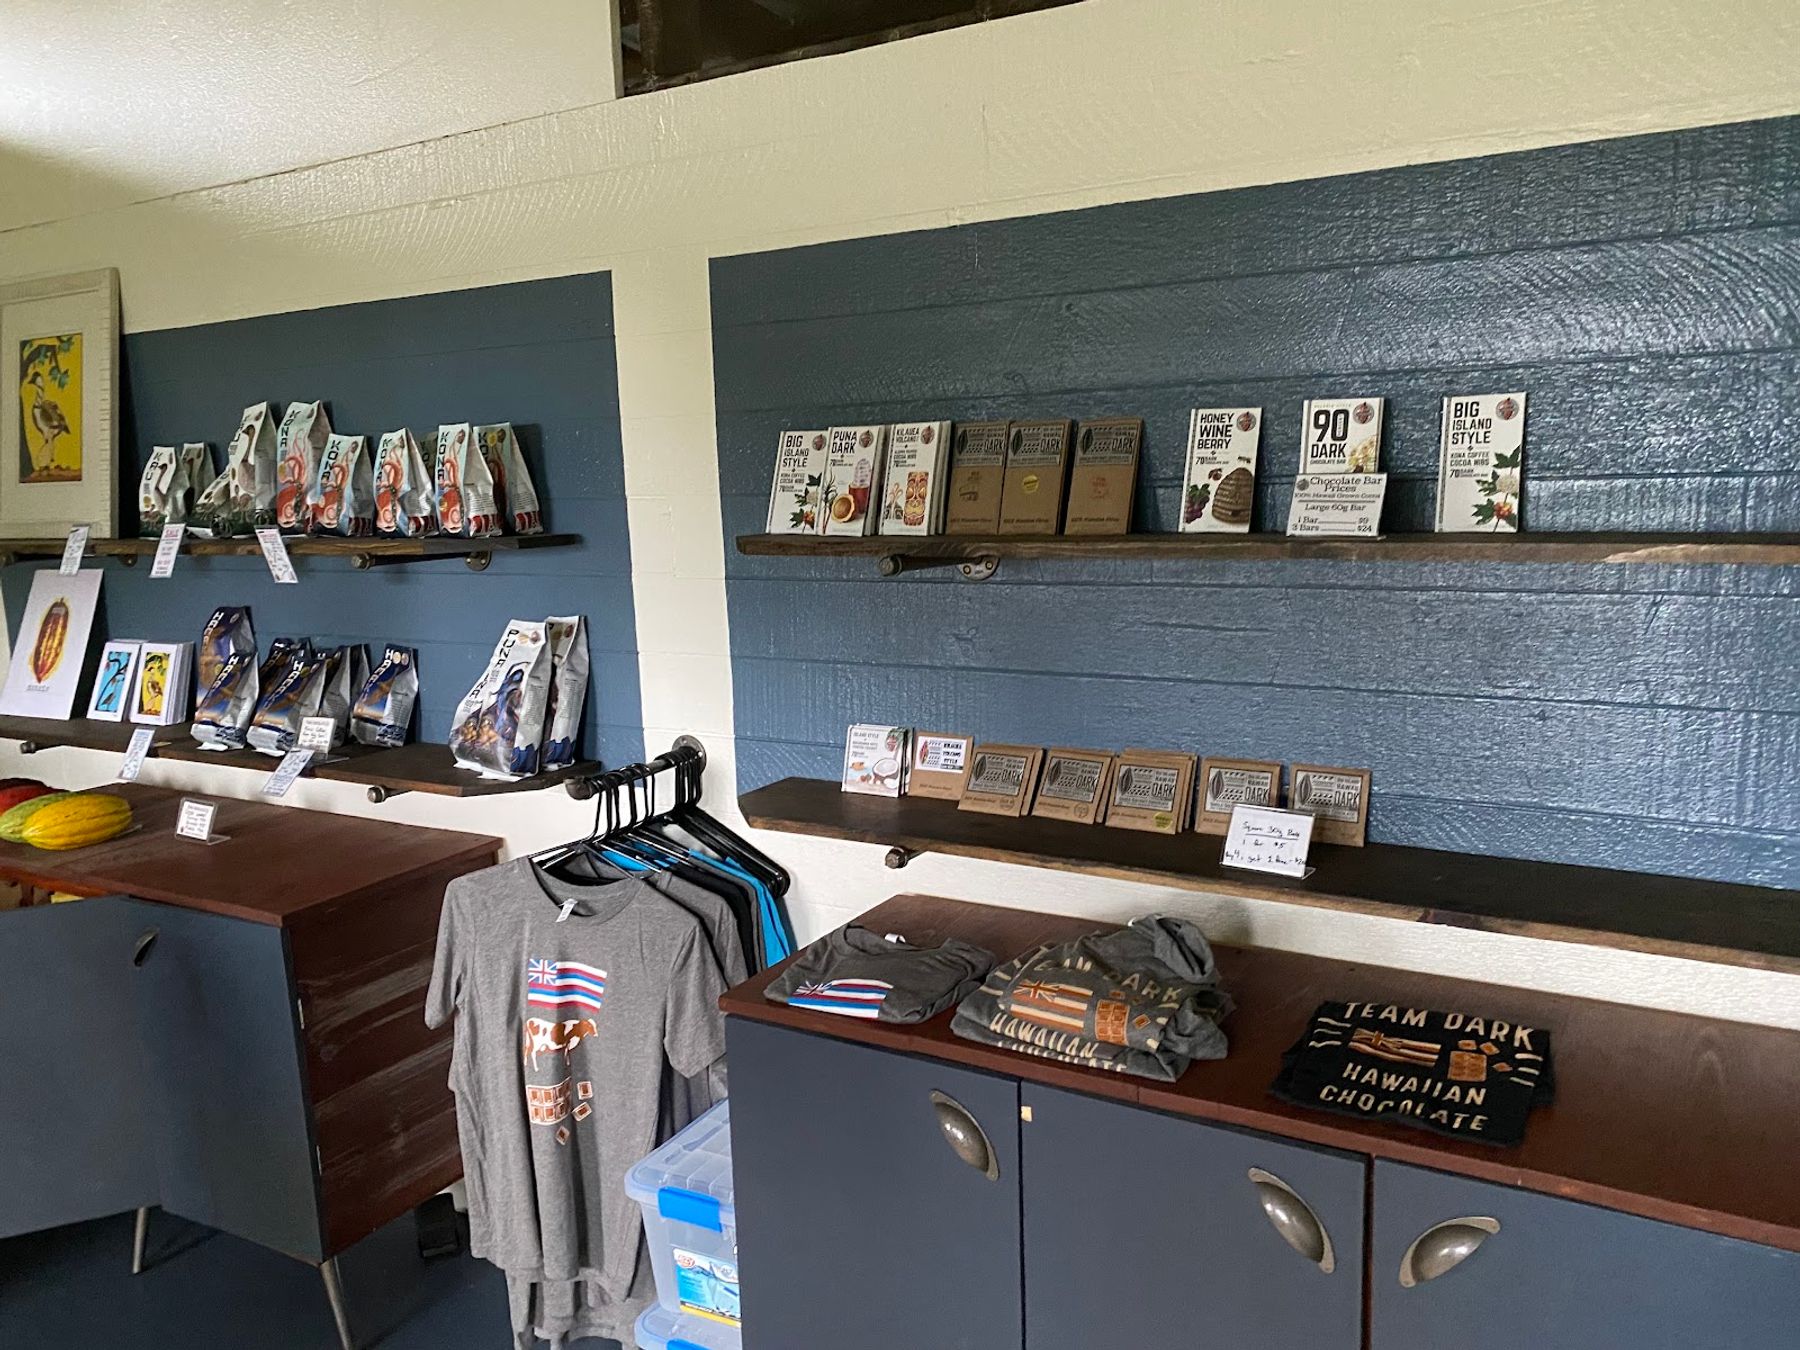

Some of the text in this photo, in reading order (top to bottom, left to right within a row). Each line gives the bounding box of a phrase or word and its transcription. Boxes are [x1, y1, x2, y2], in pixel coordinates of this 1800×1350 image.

[1454, 401, 1480, 418] BIG
[1201, 413, 1235, 423] HONEY
[1313, 409, 1349, 442] 90
[1452, 418, 1492, 431] ISLAND
[280, 410, 301, 447] KONA
[834, 431, 857, 441] PUNA
[896, 428, 919, 436] KILAUEA
[1200, 425, 1233, 438] WINE
[786, 436, 803, 447] BIG
[1040, 438, 1060, 453] DARK
[1112, 437, 1135, 453] DARK
[1197, 439, 1231, 449] BERRY
[1451, 431, 1491, 445] STYLE
[784, 448, 810, 457] ISLAND
[831, 442, 856, 454] DARK
[1311, 443, 1346, 458] DARK
[321, 440, 341, 481] KONA
[438, 432, 450, 481] KONA
[783, 457, 808, 468] STYLE
[146, 452, 163, 480] KAU
[1310, 476, 1383, 485] Chocolate Bar
[1324, 484, 1356, 492] Prices
[1305, 503, 1329, 512] Large
[1331, 504, 1348, 512] 60g
[495, 629, 520, 668] PUNA
[1076, 775, 1096, 790] DARK
[1152, 783, 1175, 798] DARK
[1245, 787, 1269, 803] DARK
[1335, 791, 1359, 808] DARK
[1343, 1002, 1536, 1051] TEAM DARK
[990, 1012, 1100, 1058] HAWAIIAN
[1342, 1062, 1487, 1106] HAWAIIAN
[1319, 1084, 1490, 1131] CHOCOLATE
